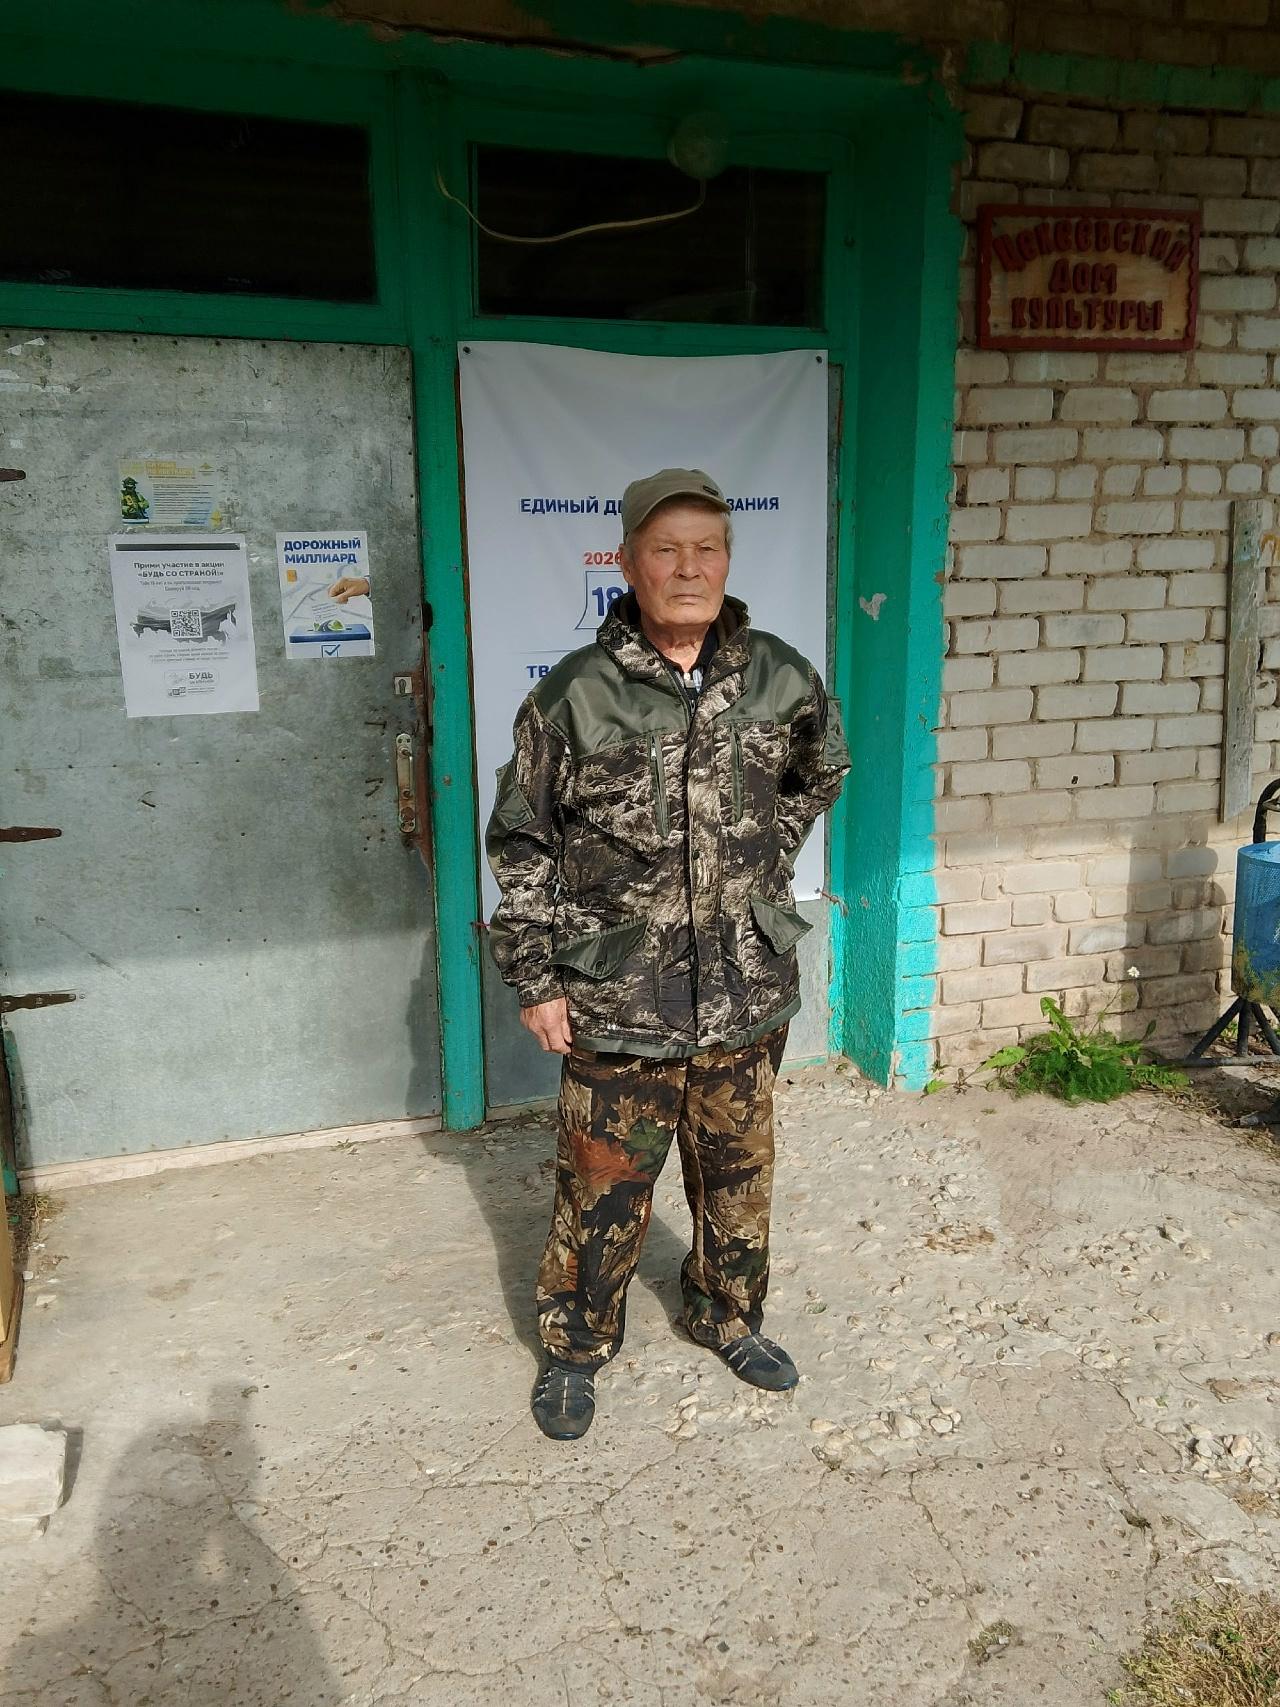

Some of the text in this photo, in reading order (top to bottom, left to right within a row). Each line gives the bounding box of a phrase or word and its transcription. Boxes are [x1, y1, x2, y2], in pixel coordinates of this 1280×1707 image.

[1048, 257, 1118, 295] ДОМ
[1011, 297, 1164, 331] КУЛЬТУРЫ
[520, 495, 599, 515] ЕДИНЫЙ
[726, 496, 780, 512] ВАНИЯ
[283, 537, 361, 552] ДОРОЖНЫЙ
[284, 553, 358, 564] МИЛЛИАРД
[133, 562, 160, 571] Прими
[188, 672, 214, 680] БУДЬ
[526, 664, 550, 679] ТВ
